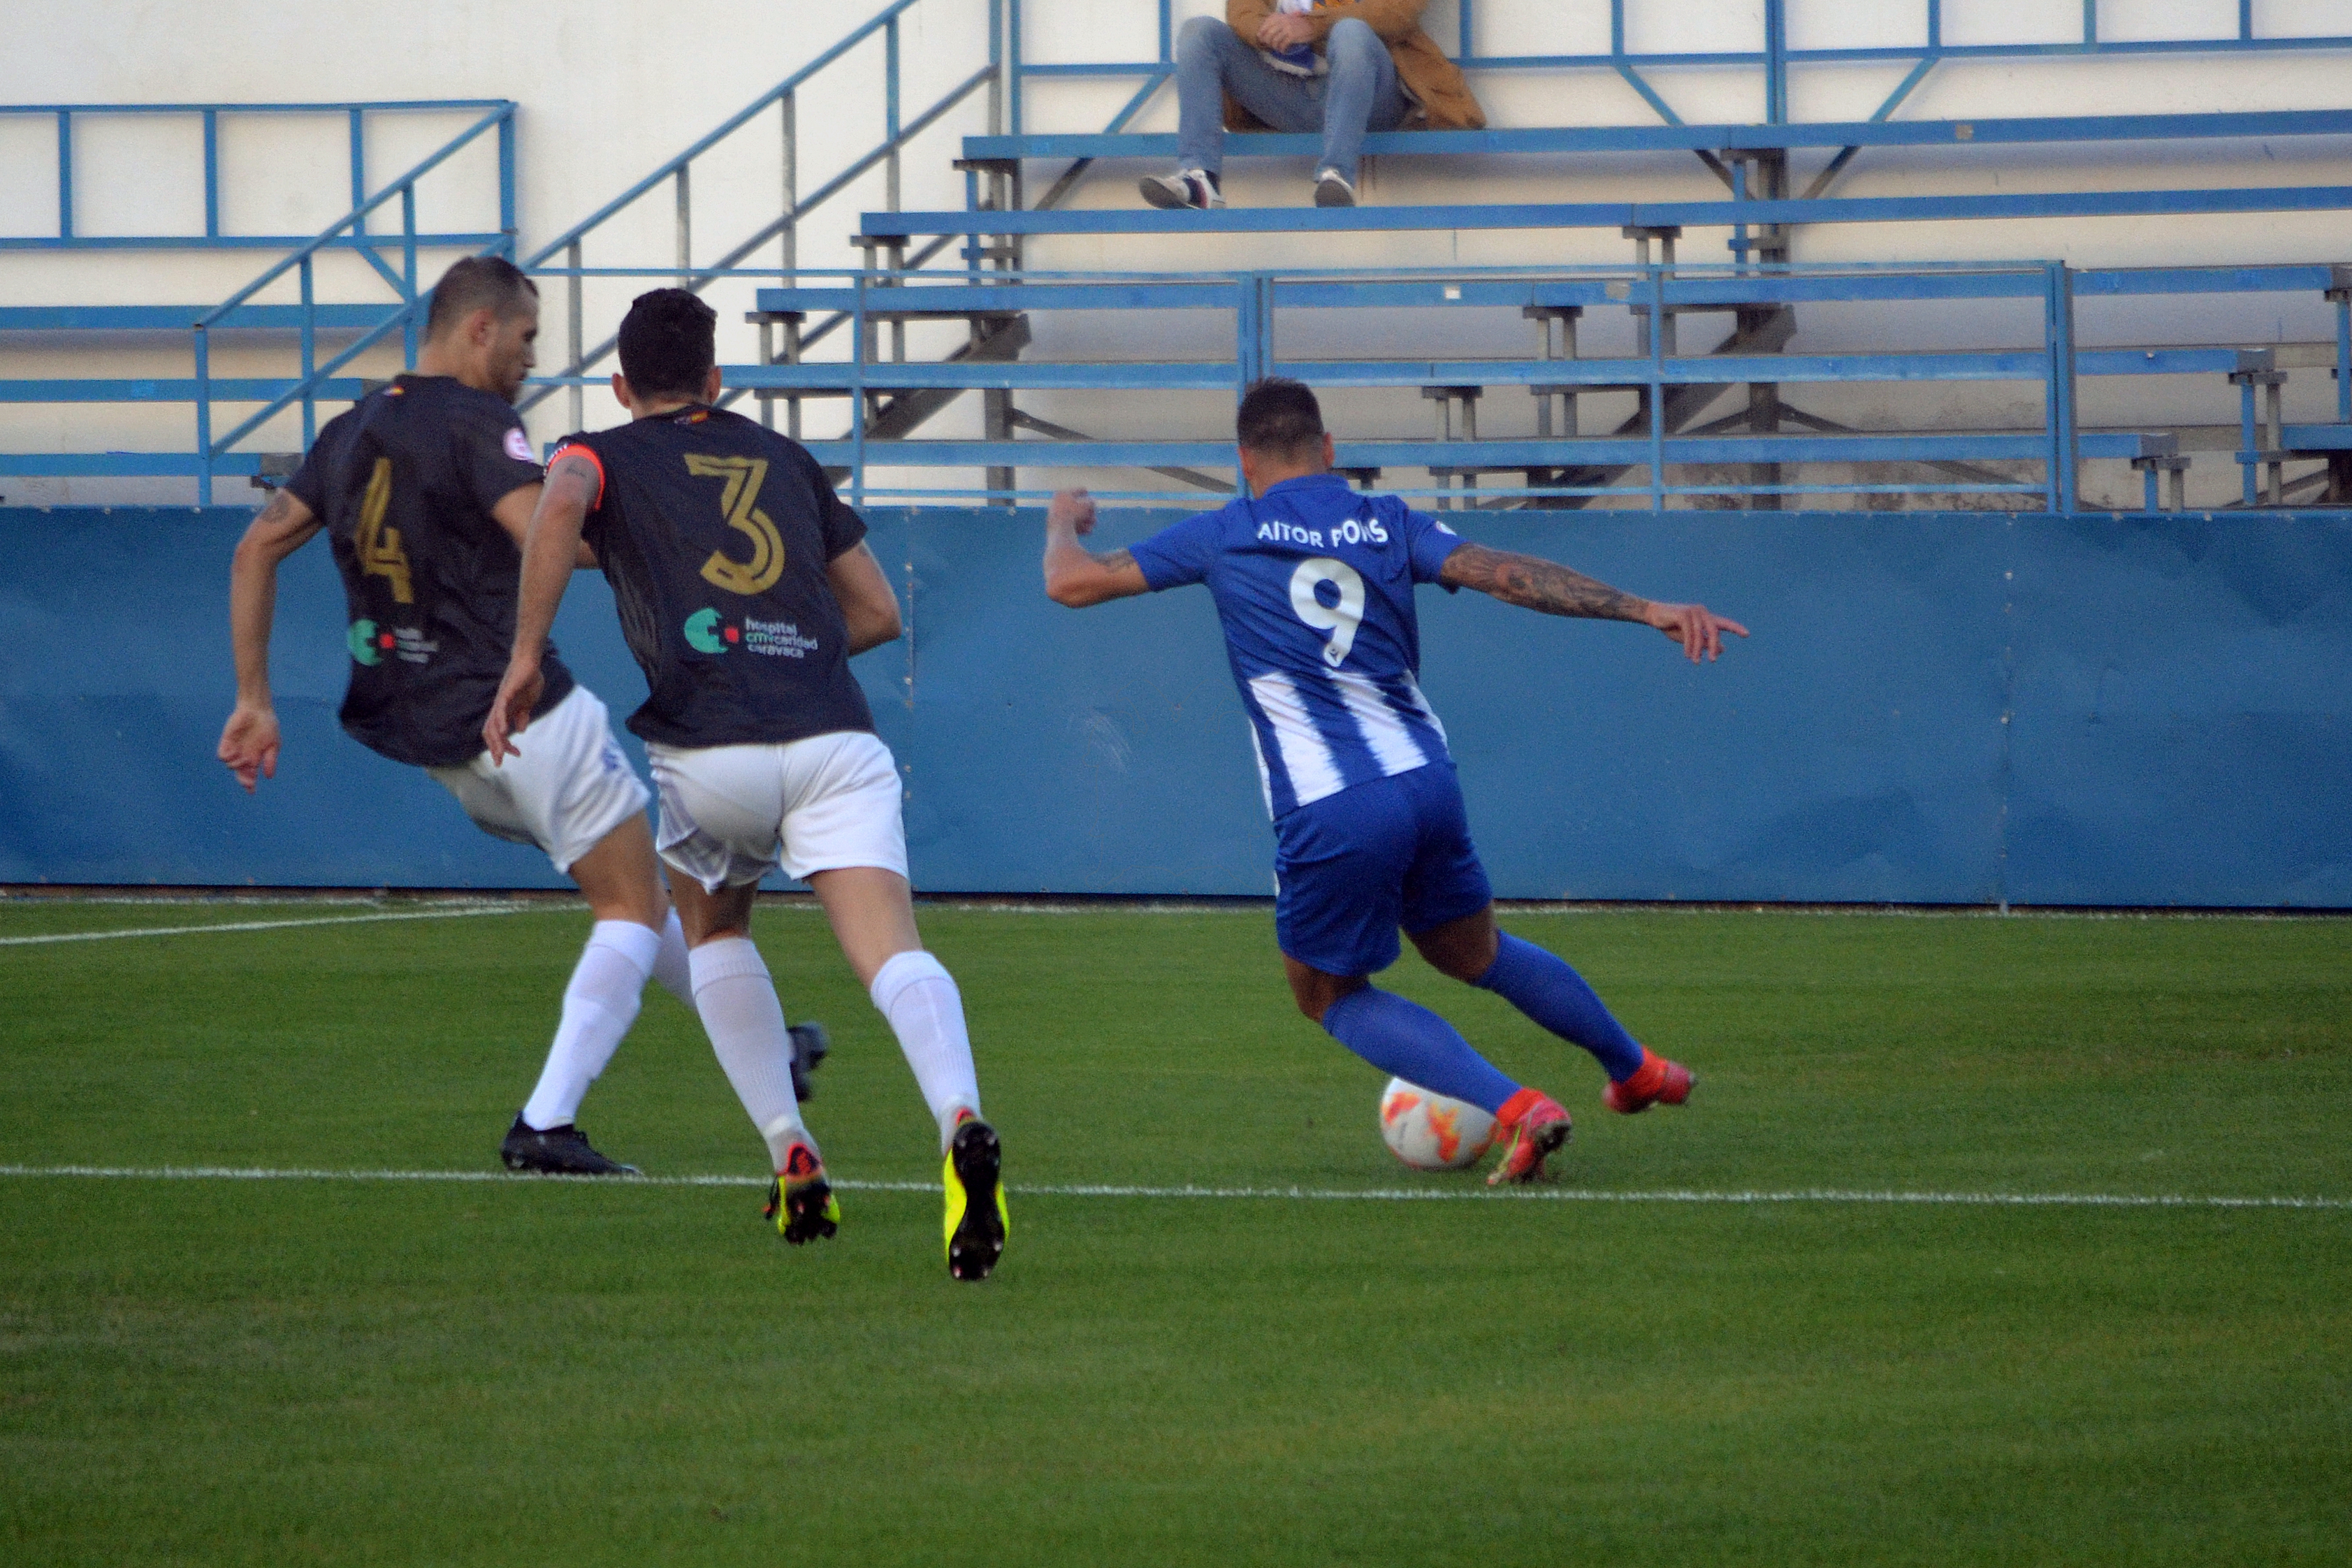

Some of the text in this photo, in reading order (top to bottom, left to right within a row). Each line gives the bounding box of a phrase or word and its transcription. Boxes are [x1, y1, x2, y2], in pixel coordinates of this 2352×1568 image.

[355, 458, 413, 604] 4
[684, 454, 785, 594] 3
[1258, 519, 1388, 548] AITOR PONS
[745, 617, 797, 635] hospital
[1291, 558, 1365, 667] 9
[748, 644, 804, 658] caravaca
